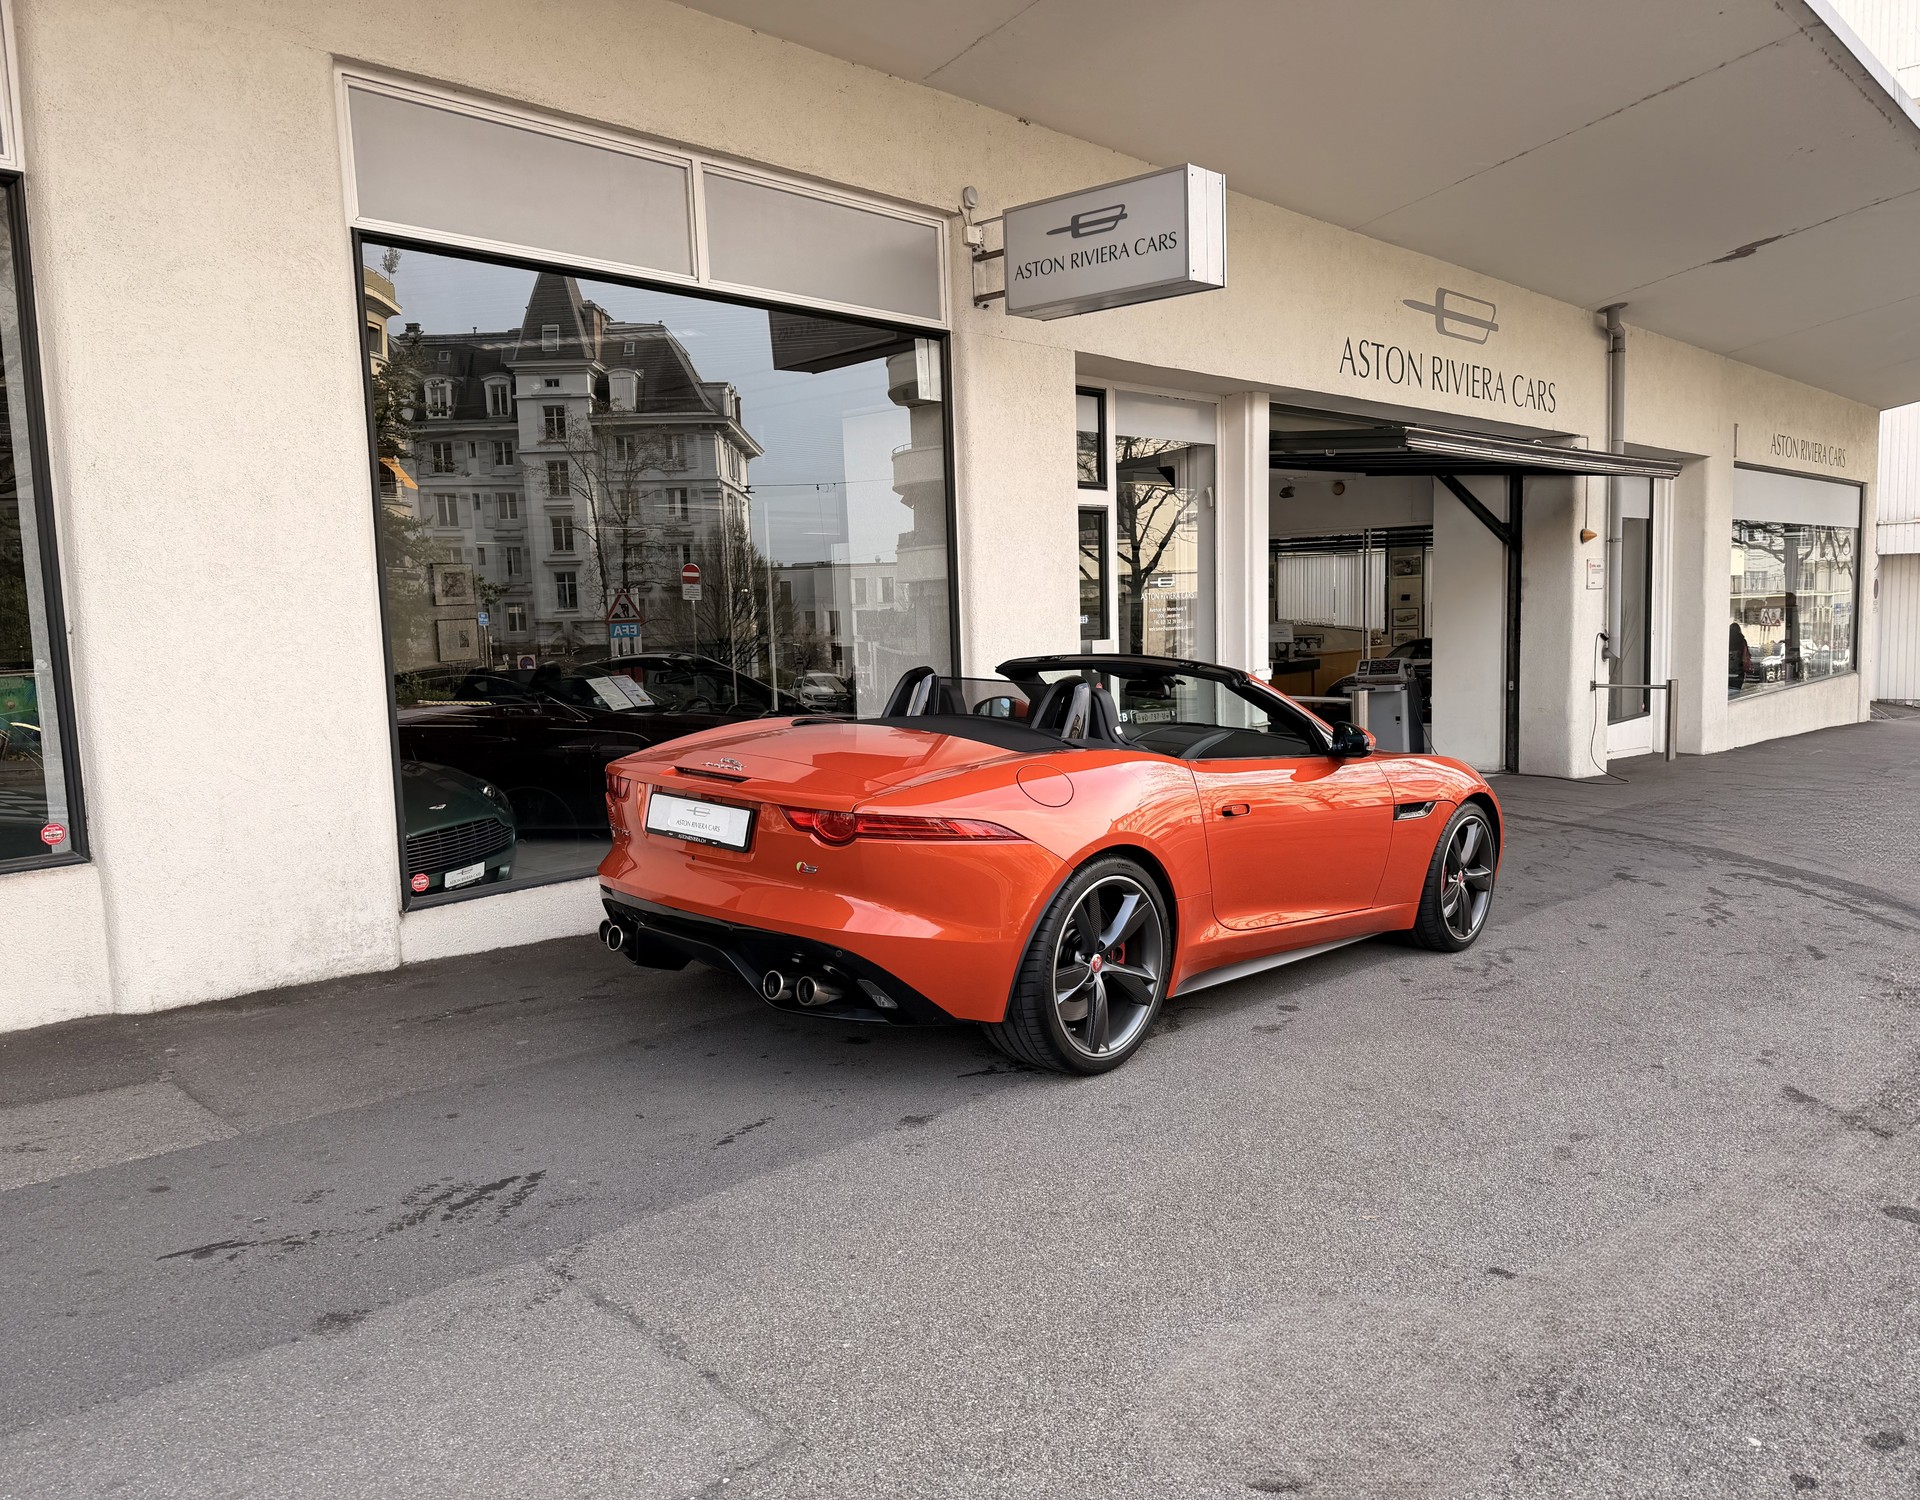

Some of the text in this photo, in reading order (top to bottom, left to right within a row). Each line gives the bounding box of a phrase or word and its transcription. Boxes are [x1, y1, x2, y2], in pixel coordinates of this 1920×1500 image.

[1014, 231, 1178, 281] ASTON RIVIERA CARS
[1339, 336, 1556, 414] ASTON RIVIERA CARS
[1770, 433, 1847, 468] ASTON RIVIERA CARS
[1140, 592, 1160, 600] ASTON
[676, 818, 721, 833] ASTON RIVIERA CARS
